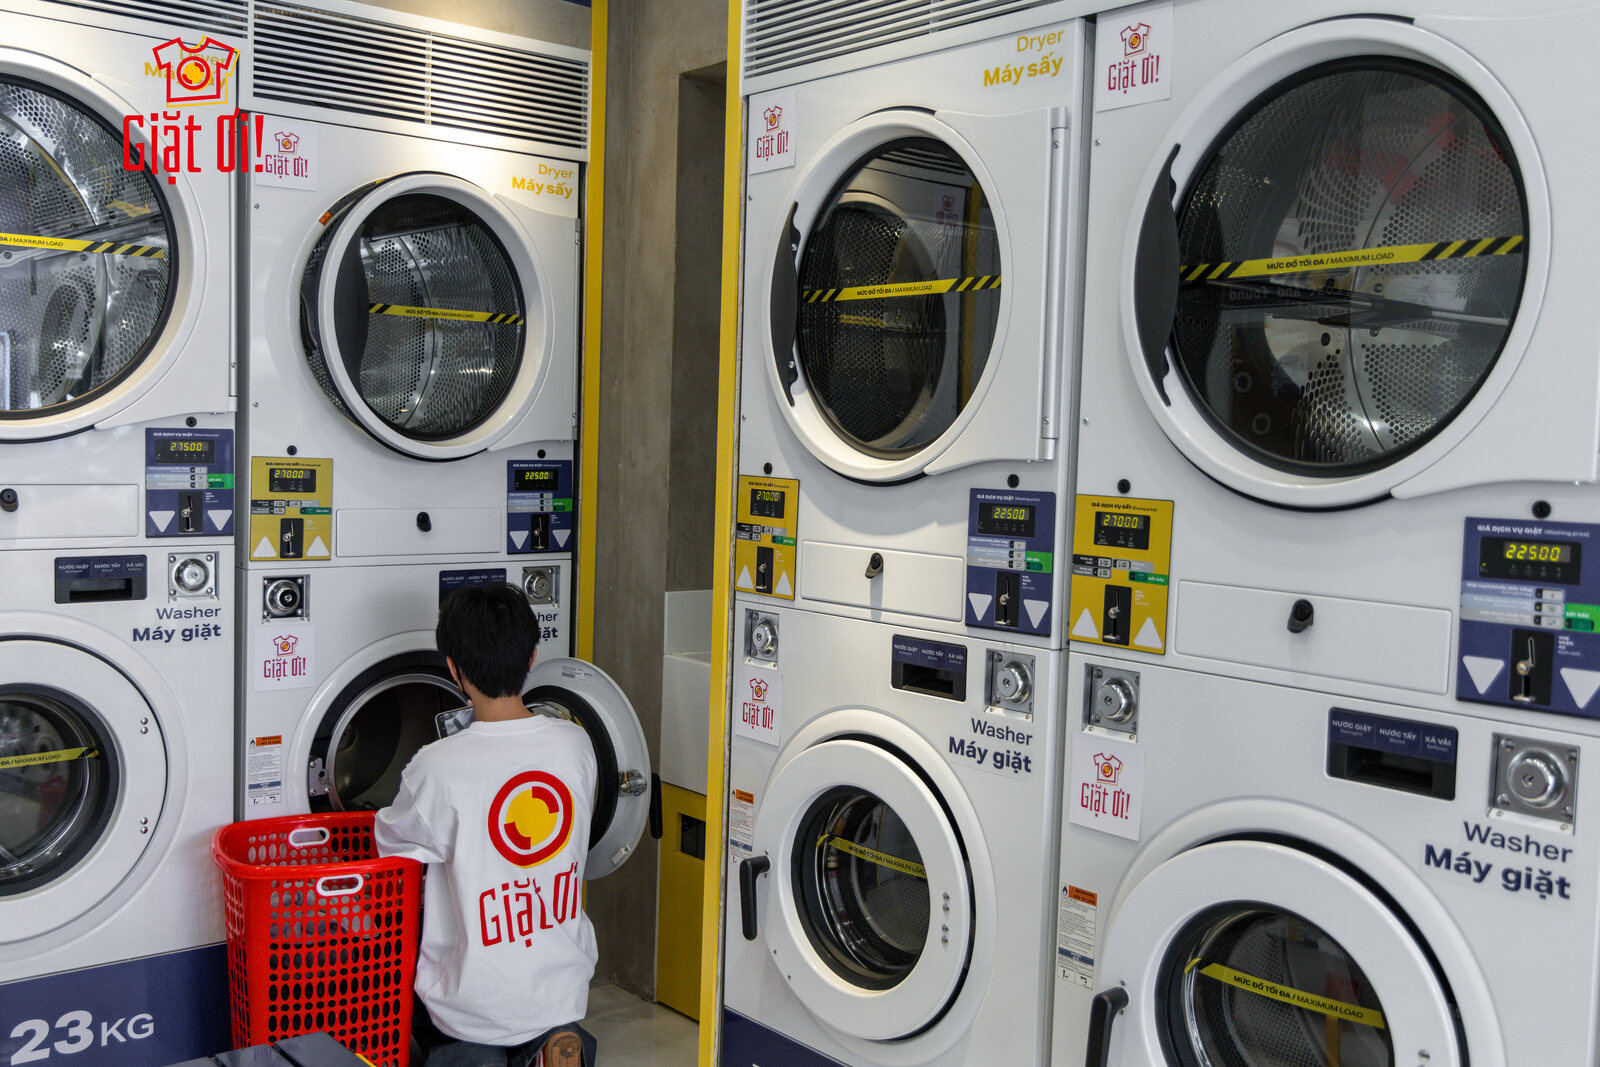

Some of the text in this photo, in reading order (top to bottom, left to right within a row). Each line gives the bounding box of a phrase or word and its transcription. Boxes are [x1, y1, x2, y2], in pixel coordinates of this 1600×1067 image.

[1016, 30, 1065, 53] Dryer
[983, 51, 1064, 87] Máy sấy
[1108, 59, 1137, 95] Giặt
[756, 133, 775, 162] Giặt
[265, 154, 290, 178] Giặt
[538, 163, 574, 180] Dryer
[512, 176, 573, 199] Máy sấy
[1313, 258, 1325, 266] ĐA
[1330, 254, 1370, 264] MAXIMUM
[1371, 252, 1394, 262] LOAD
[919, 284, 933, 292] LOAD
[170, 442, 203, 451] 27500
[274, 470, 304, 479] 27000
[525, 471, 549, 480] 22500
[756, 490, 779, 502] 27000
[994, 508, 1026, 520] 22500
[1103, 514, 1139, 529] 27000
[1477, 524, 1490, 532] GIÁ
[1492, 525, 1511, 534] DỊCH
[1512, 527, 1523, 535] VỤ
[1524, 527, 1542, 536] GIẶT
[1505, 544, 1561, 562] 22500
[156, 607, 222, 621] Washer
[537, 612, 558, 622] her
[132, 623, 222, 643] Máy giặt
[264, 658, 288, 681] Giặt
[742, 702, 760, 729] Giặt
[971, 717, 1033, 746] Washer
[1332, 719, 1372, 733] NƯỚC GIẶT
[1379, 727, 1402, 738] NƯỚC
[948, 736, 1032, 773] Máy giặt
[1080, 782, 1109, 818] Giặt
[1463, 820, 1573, 864] Washer
[885, 858, 912, 871] MAXIMUM
[1424, 843, 1571, 900] Máy giặt
[479, 877, 554, 949] Giặt
[1233, 975, 1251, 987] MỨC
[1265, 984, 1278, 995] TỐI
[1279, 990, 1291, 999] ĐA
[1296, 994, 1339, 1013] MAXIMUM
[1339, 1007, 1364, 1019] LOAD
[10, 1010, 154, 1066] 23 KG
